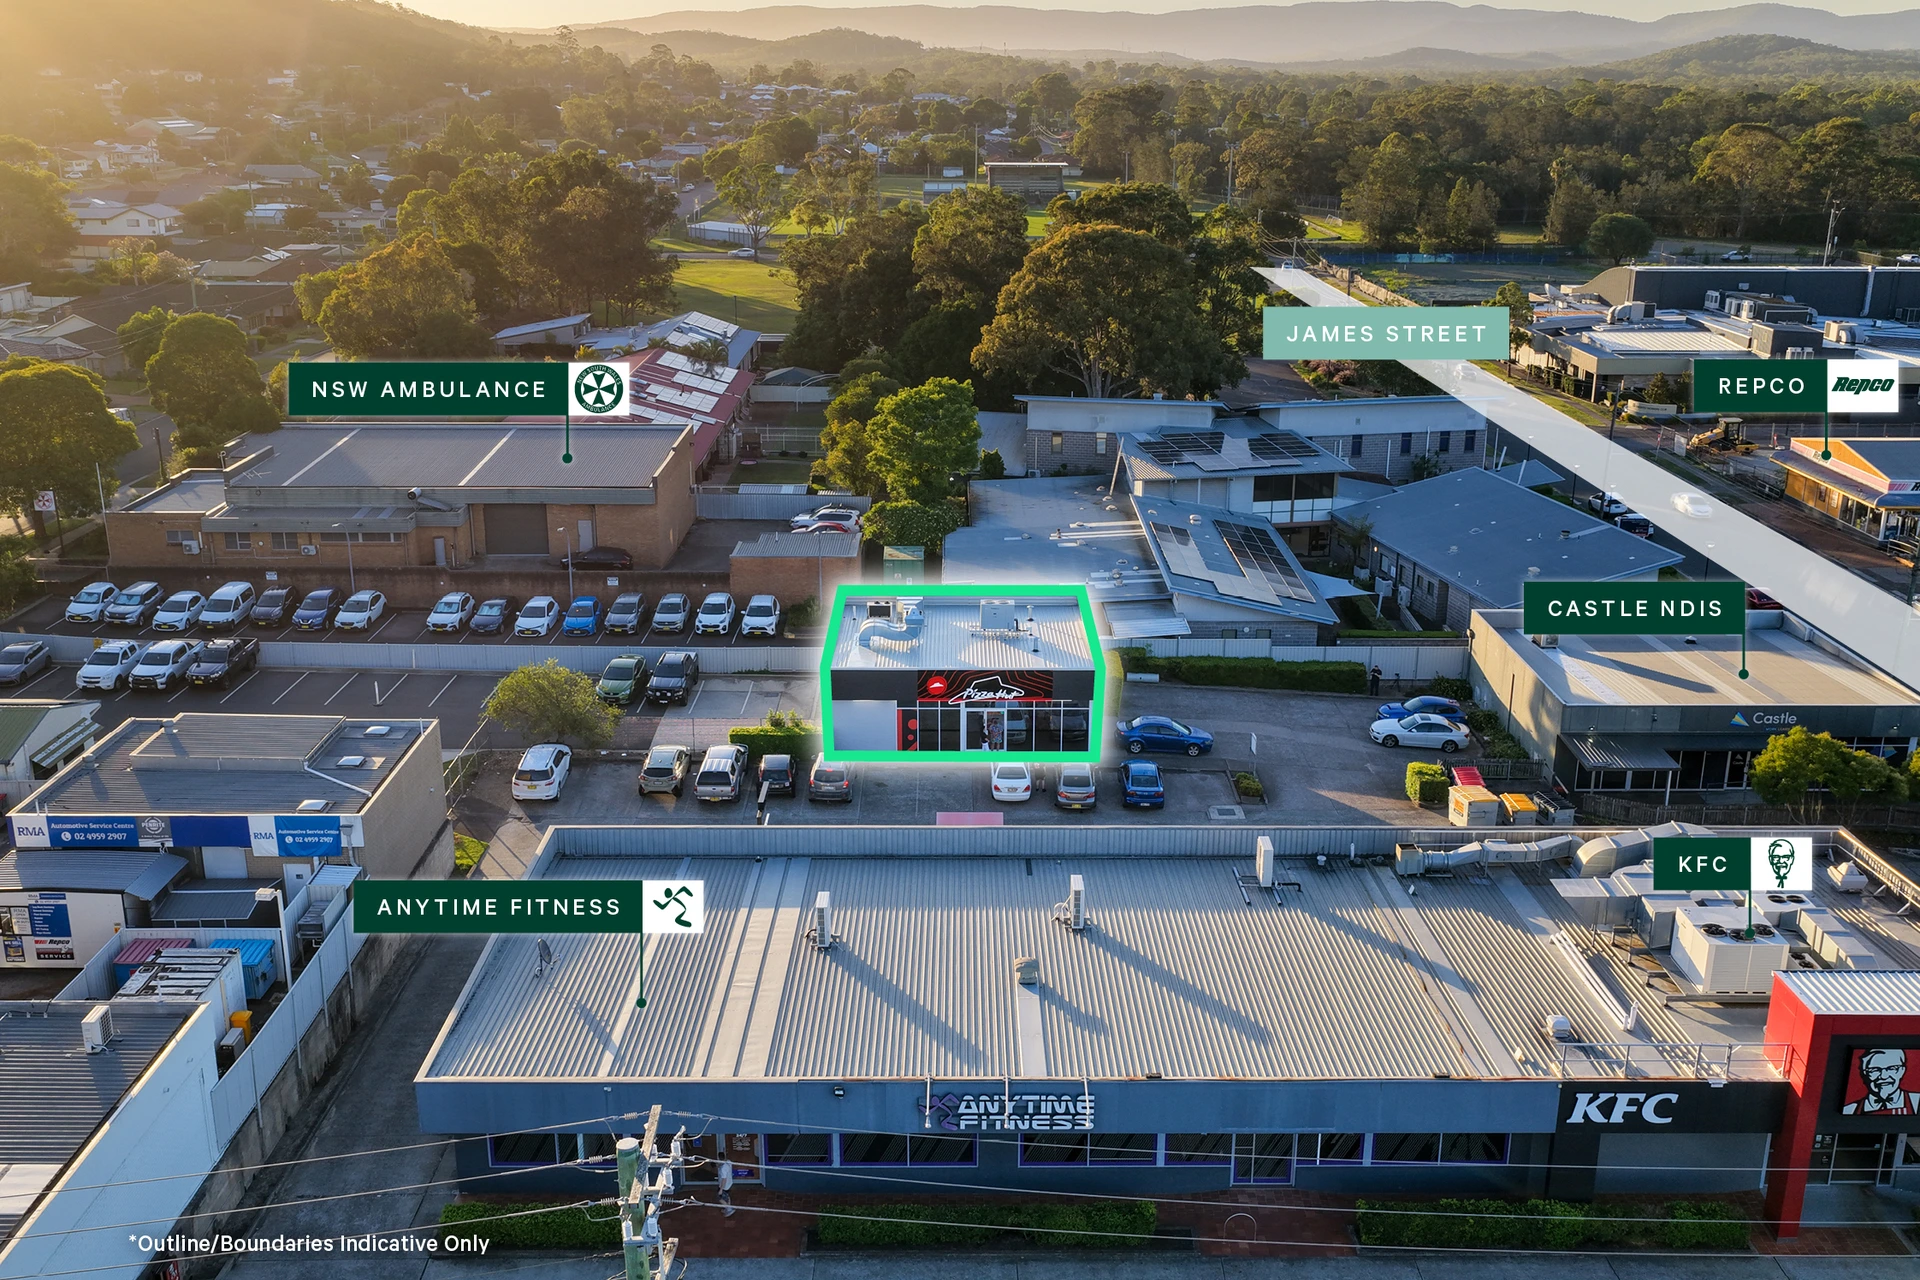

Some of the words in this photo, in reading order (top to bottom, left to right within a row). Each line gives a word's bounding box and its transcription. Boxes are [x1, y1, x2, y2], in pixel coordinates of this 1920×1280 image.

[963, 688, 994, 699] Pizza
[995, 689, 1017, 699] Hut
[1753, 712, 1797, 724] Castle
[17, 826, 46, 837] RMA
[74, 832, 86, 841] 02
[86, 832, 106, 841] 4959
[107, 832, 127, 841] 2907
[253, 832, 274, 840] RMA
[319, 836, 334, 844] 2907
[957, 1095, 1095, 1114] ANYTIME
[1566, 1092, 1679, 1124] KFC
[959, 1115, 1095, 1130] FITNESS
